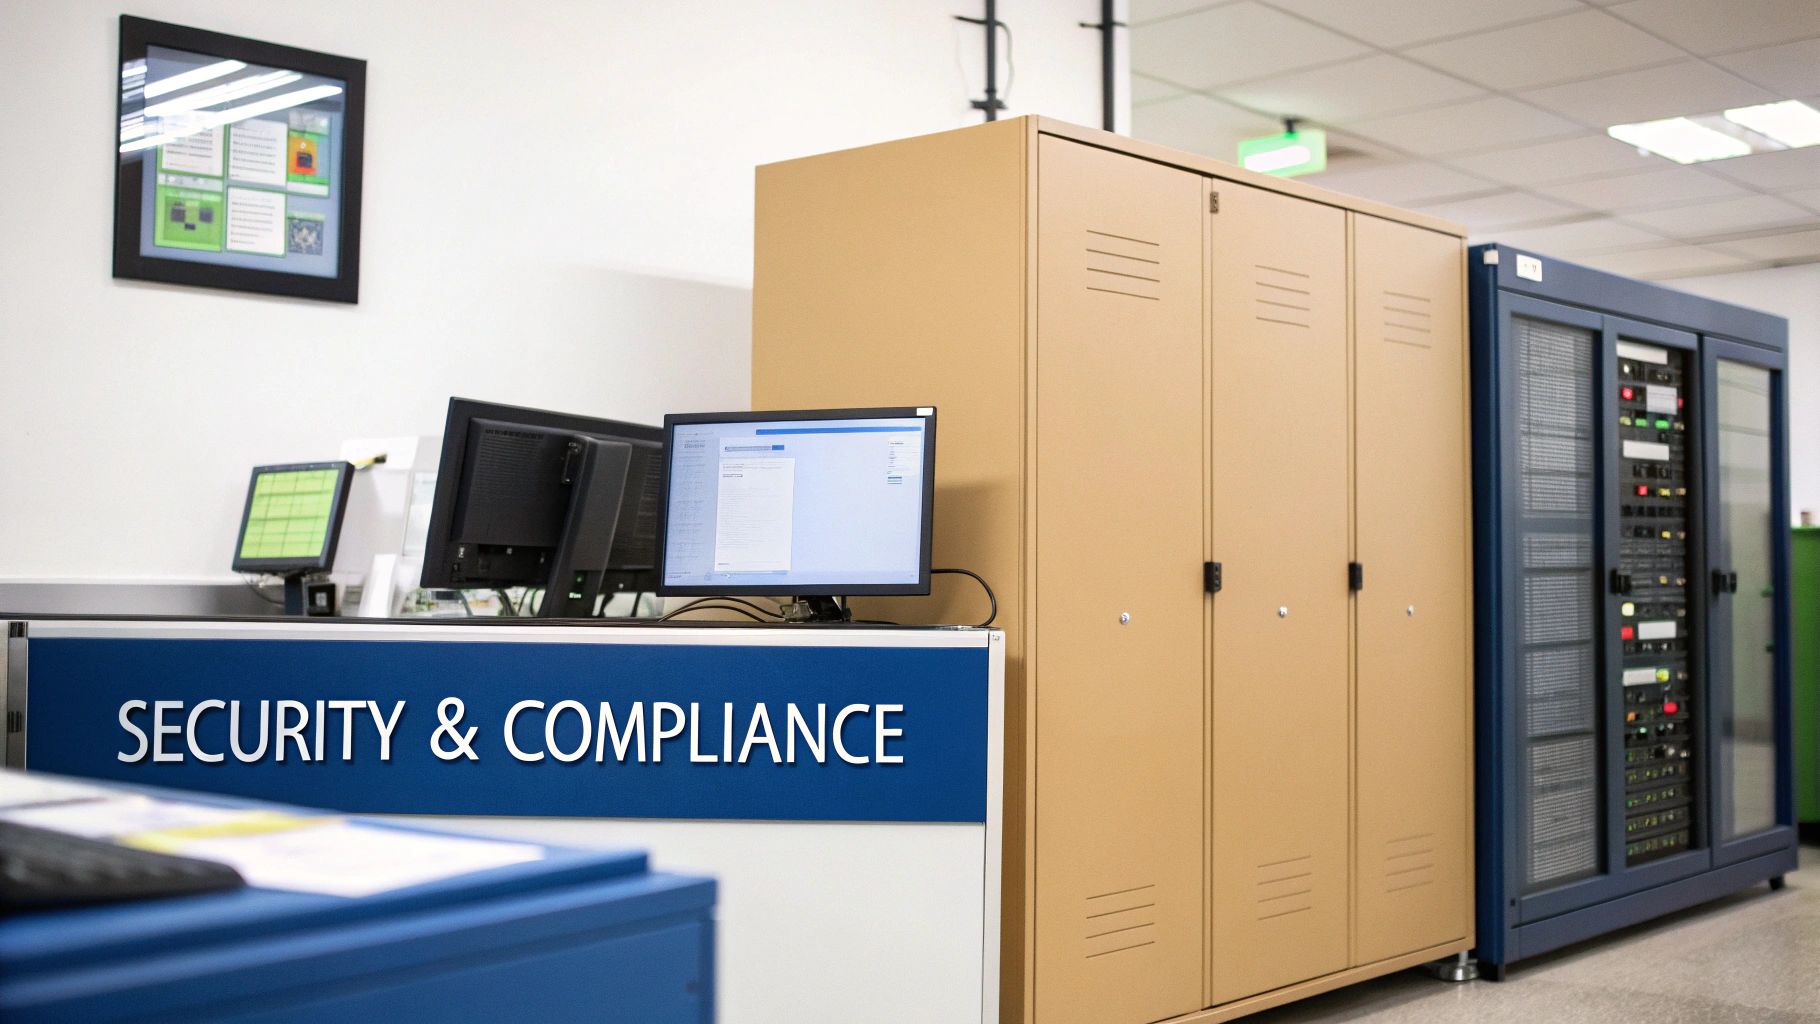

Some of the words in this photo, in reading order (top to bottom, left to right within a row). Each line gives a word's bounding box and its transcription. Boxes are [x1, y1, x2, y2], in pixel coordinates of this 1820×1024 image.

[117, 698, 406, 764] SECURITY
[430, 696, 480, 761] &
[503, 699, 904, 765] COMPLIANCE
